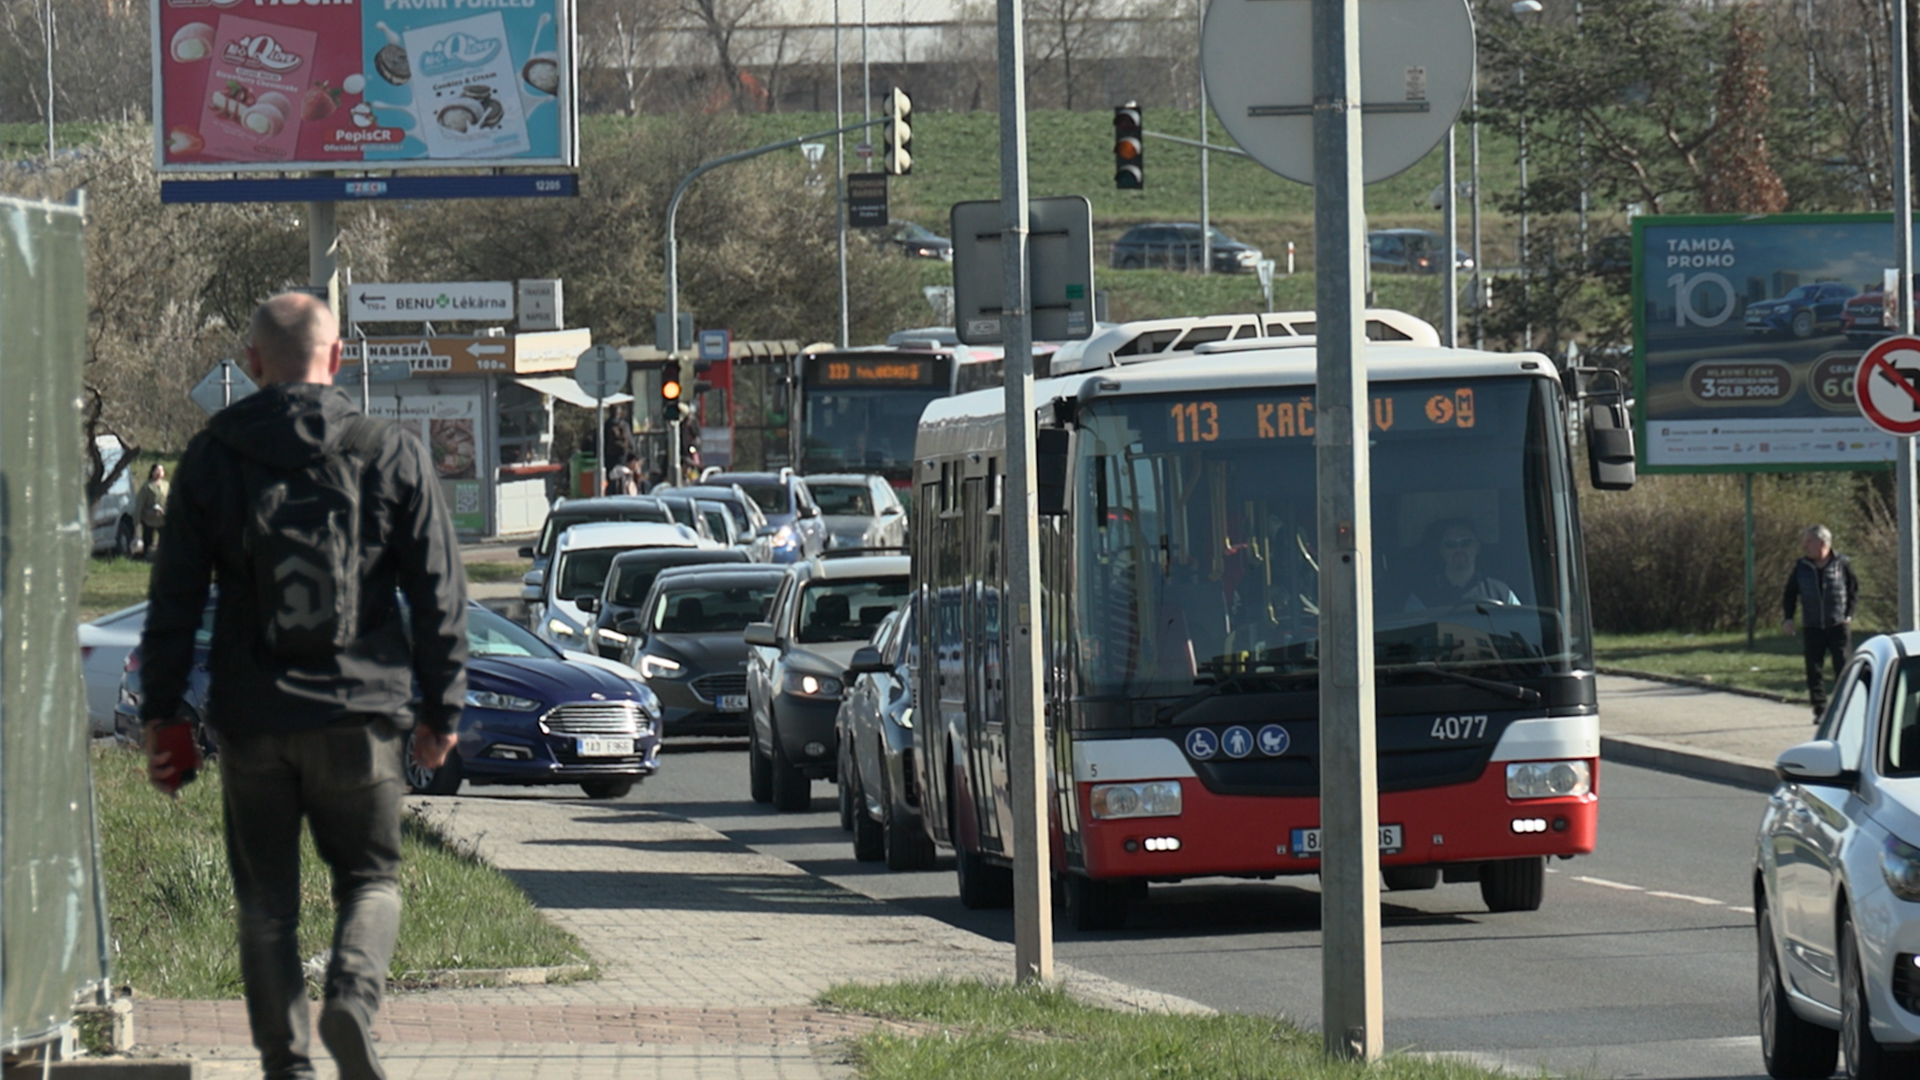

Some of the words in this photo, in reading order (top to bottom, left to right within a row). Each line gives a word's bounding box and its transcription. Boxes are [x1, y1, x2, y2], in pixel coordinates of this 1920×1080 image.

[472, 72, 497, 82] Cream
[335, 129, 391, 142] PepisCR
[1666, 238, 1735, 252] TAMDA
[1666, 254, 1736, 268] PROMO
[395, 298, 435, 310] BENU
[452, 296, 506, 309] Lékárna
[1666, 271, 1737, 329] 10
[1701, 378, 1716, 397] 3
[1717, 385, 1744, 397] GLB
[1746, 385, 1779, 396] 200d
[1171, 402, 1219, 443] 113
[1430, 715, 1488, 739] 4077
[1090, 763, 1098, 778] 5
